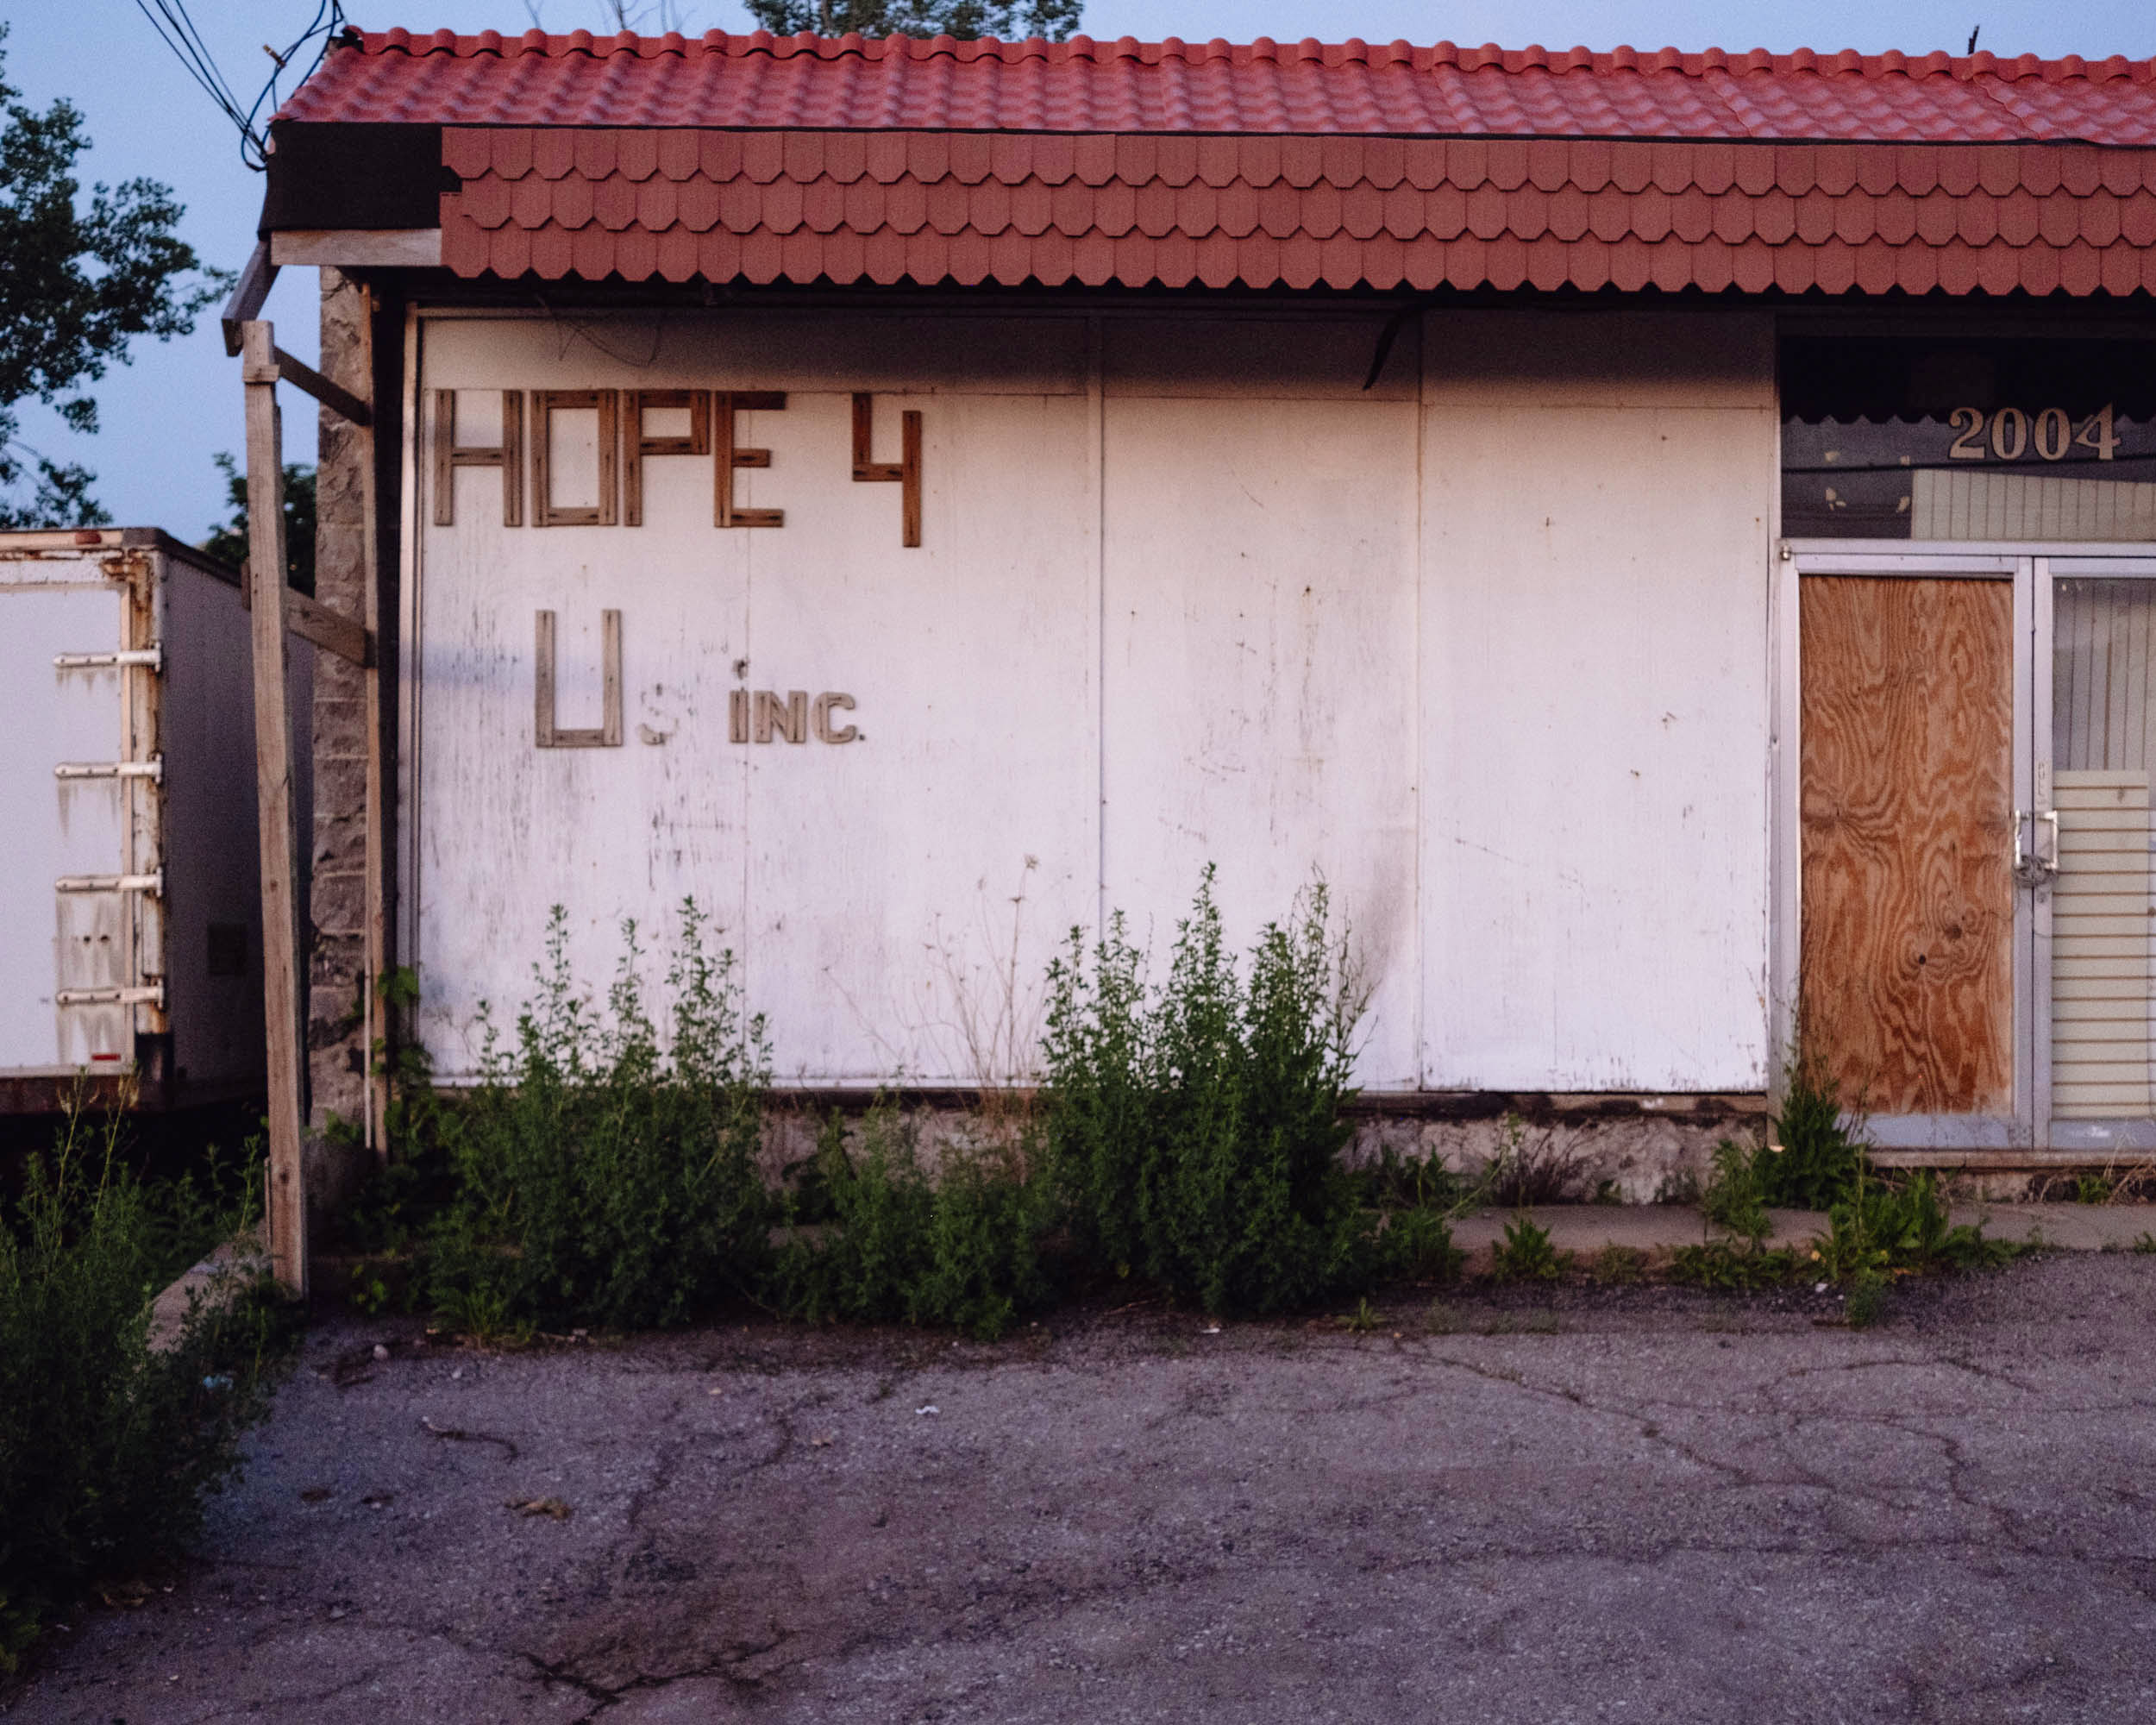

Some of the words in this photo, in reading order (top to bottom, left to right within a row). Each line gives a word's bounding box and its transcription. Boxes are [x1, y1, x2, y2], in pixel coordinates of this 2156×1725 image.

[434, 388, 786, 527] HOPE
[851, 391, 921, 548] 4
[1948, 402, 2121, 461] 2004
